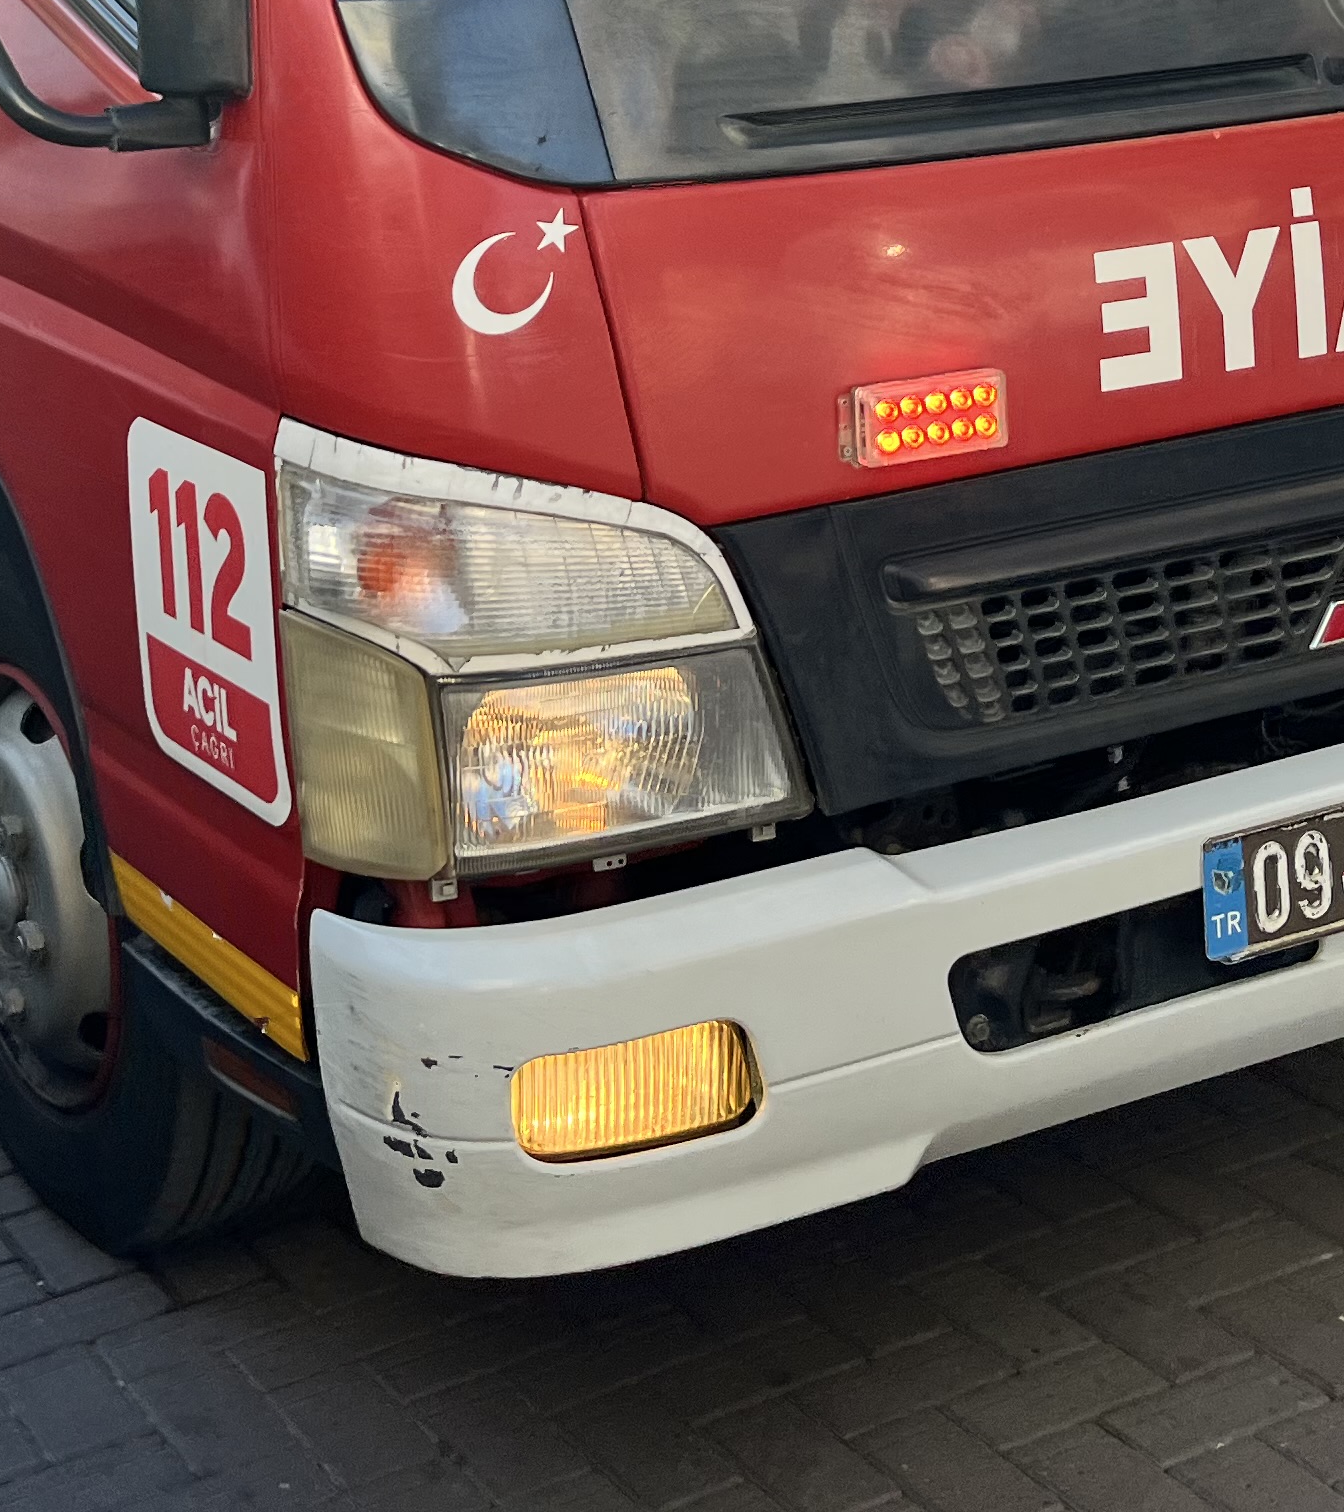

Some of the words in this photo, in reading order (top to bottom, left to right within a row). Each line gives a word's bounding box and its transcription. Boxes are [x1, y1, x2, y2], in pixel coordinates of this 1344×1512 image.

[148, 467, 253, 662] 112
[190, 724, 235, 771] ÇAĞRI
[1251, 830, 1333, 934] 09
[1210, 911, 1242, 939] TR
